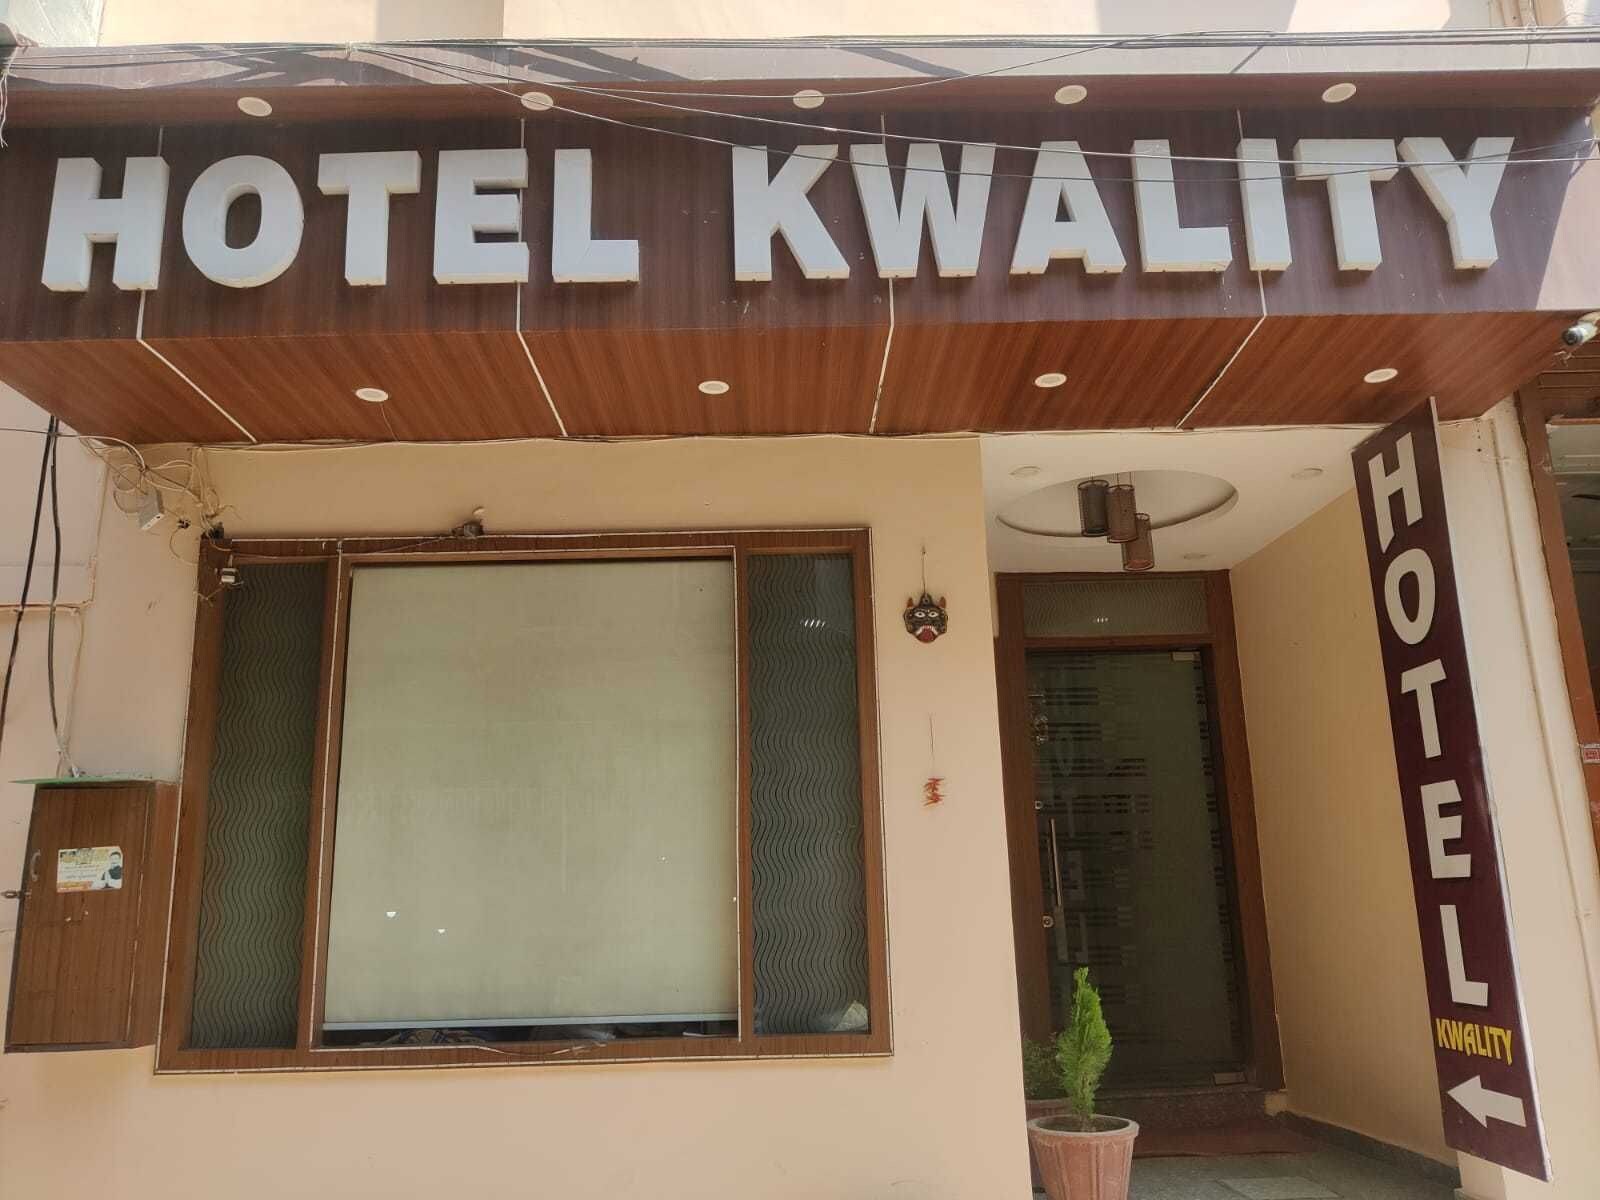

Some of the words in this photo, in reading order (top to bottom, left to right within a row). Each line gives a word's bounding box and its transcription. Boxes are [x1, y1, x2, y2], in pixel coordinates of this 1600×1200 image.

[41, 148, 641, 292] HOTEL
[732, 137, 1514, 283] KWALITY
[1368, 431, 1489, 1006] HOTEL
[1435, 1017, 1513, 1065] KWALITY
